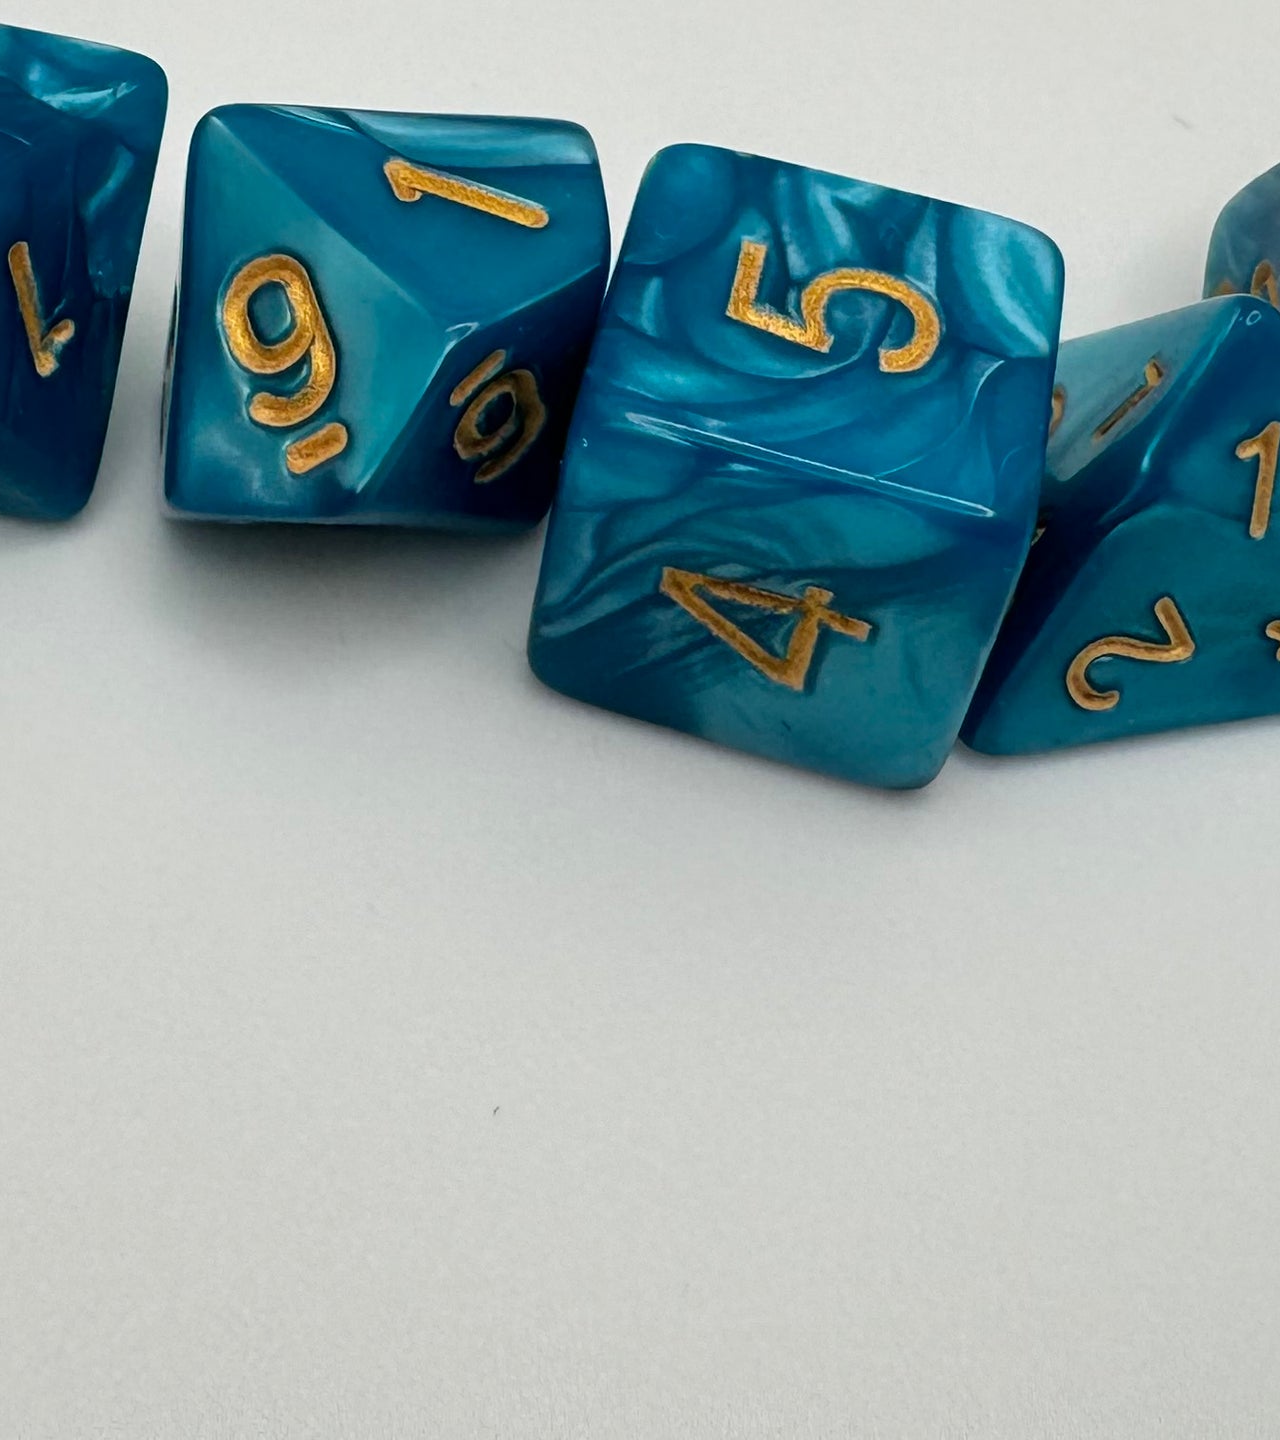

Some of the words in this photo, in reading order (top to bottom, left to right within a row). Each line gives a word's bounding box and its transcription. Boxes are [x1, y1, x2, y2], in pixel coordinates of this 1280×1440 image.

[383, 157, 550, 230] 1
[726, 238, 941, 374] 5
[660, 566, 873, 691] 4
[1065, 596, 1196, 712] 2
